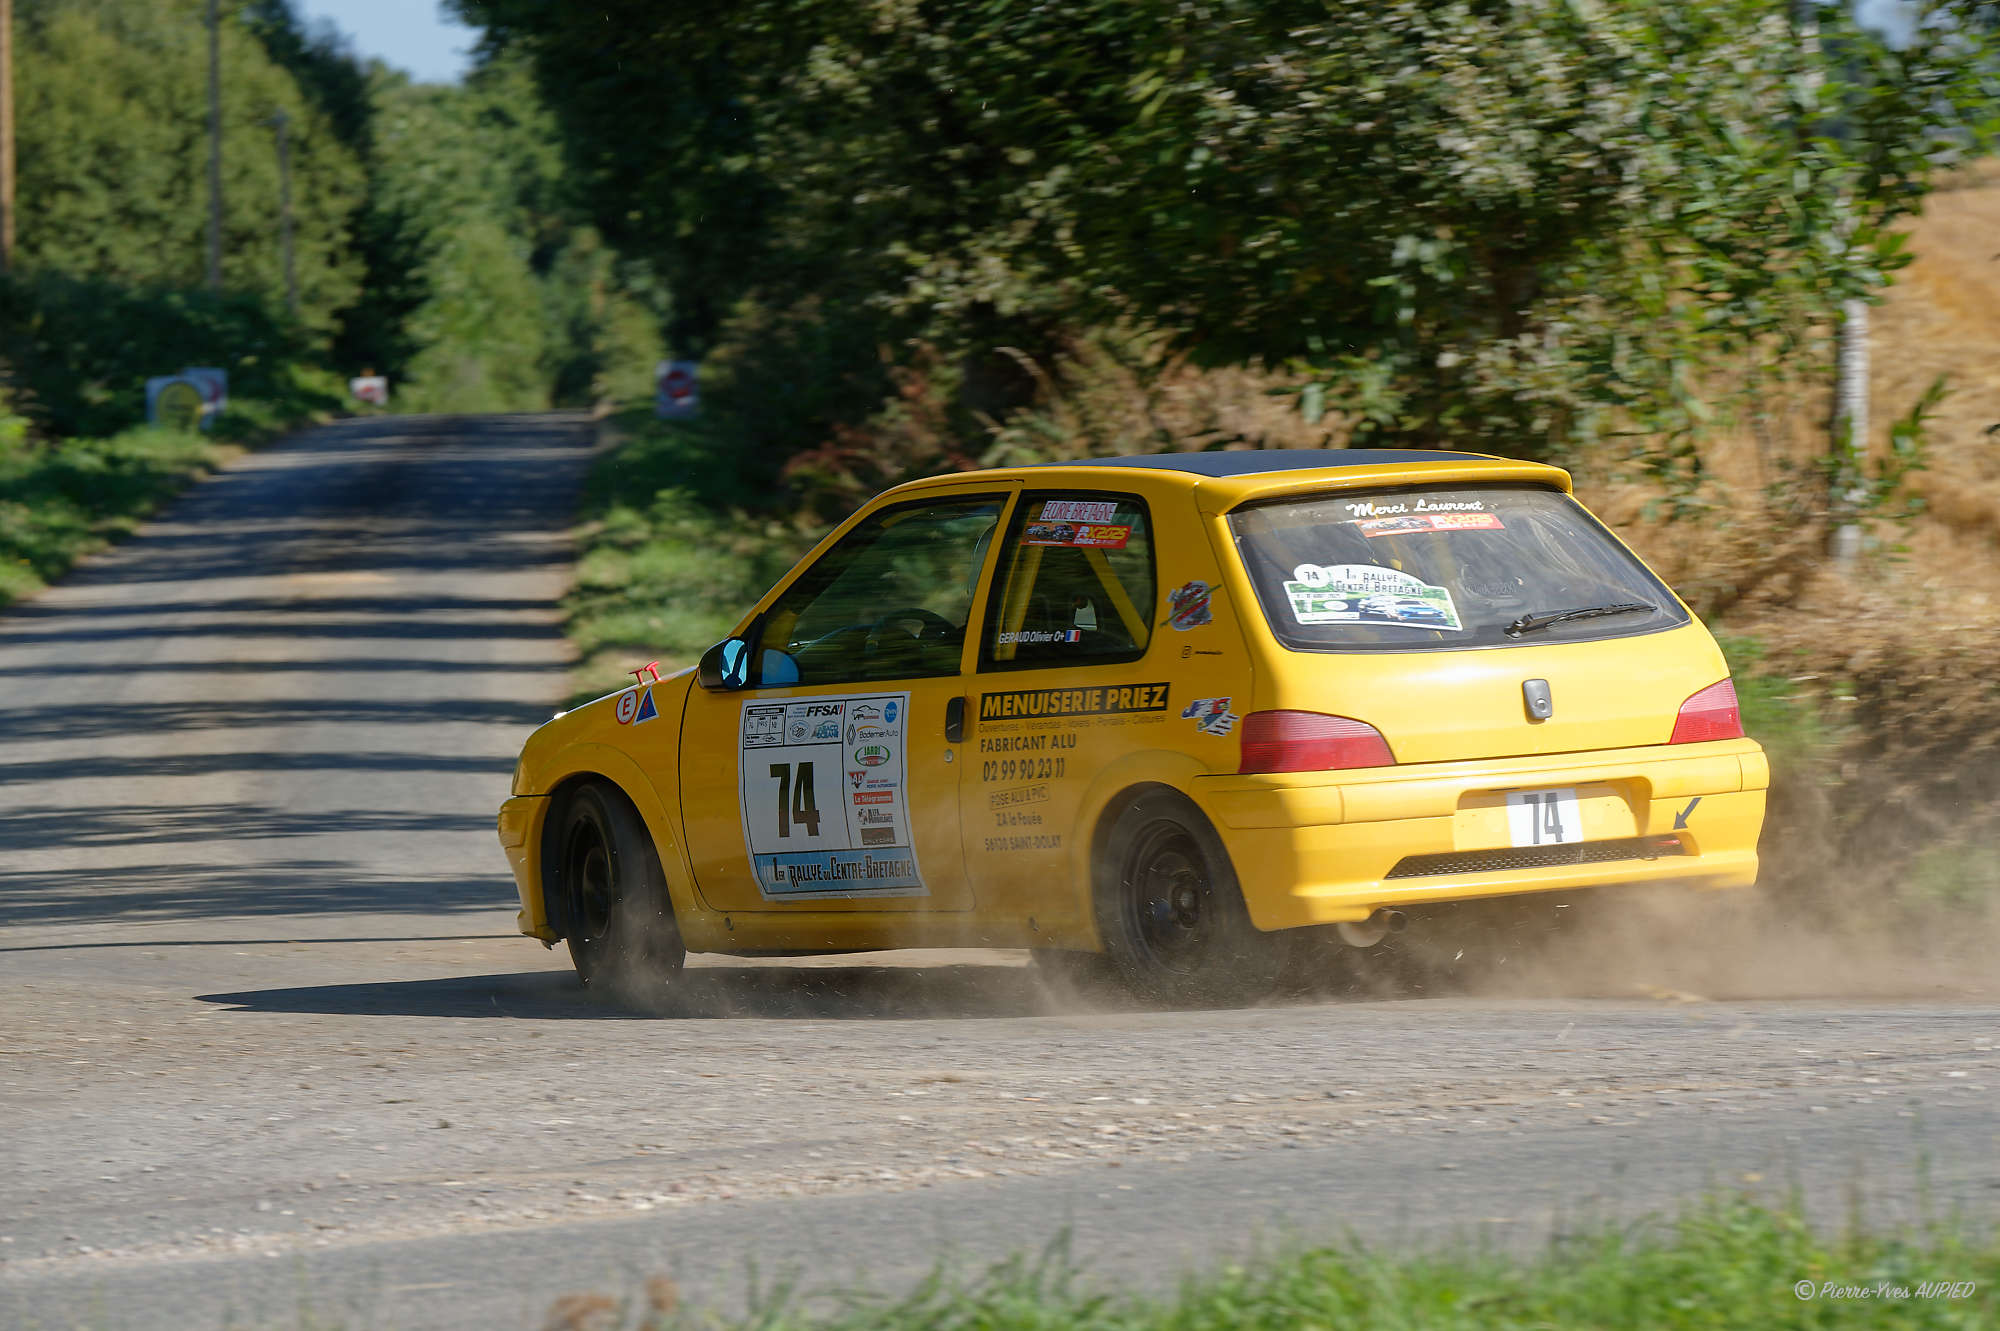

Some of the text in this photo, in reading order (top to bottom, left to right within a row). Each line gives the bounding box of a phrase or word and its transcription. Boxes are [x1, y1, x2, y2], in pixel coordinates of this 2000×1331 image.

[1346, 499, 1484, 517] Merci Laurent
[1304, 571, 1319, 580] 74
[622, 697, 631, 716] E
[806, 705, 840, 718] FFSA
[983, 686, 1166, 718] MENUISERIE PRIEZ
[980, 734, 1077, 753] FABRICANT ALU
[983, 761, 998, 782] 02
[1001, 759, 1016, 779] 99
[1019, 758, 1034, 779] 90
[1038, 757, 1052, 778] 23
[769, 761, 821, 838] 74
[1523, 792, 1563, 844] 74
[789, 864, 823, 888] RALLYE
